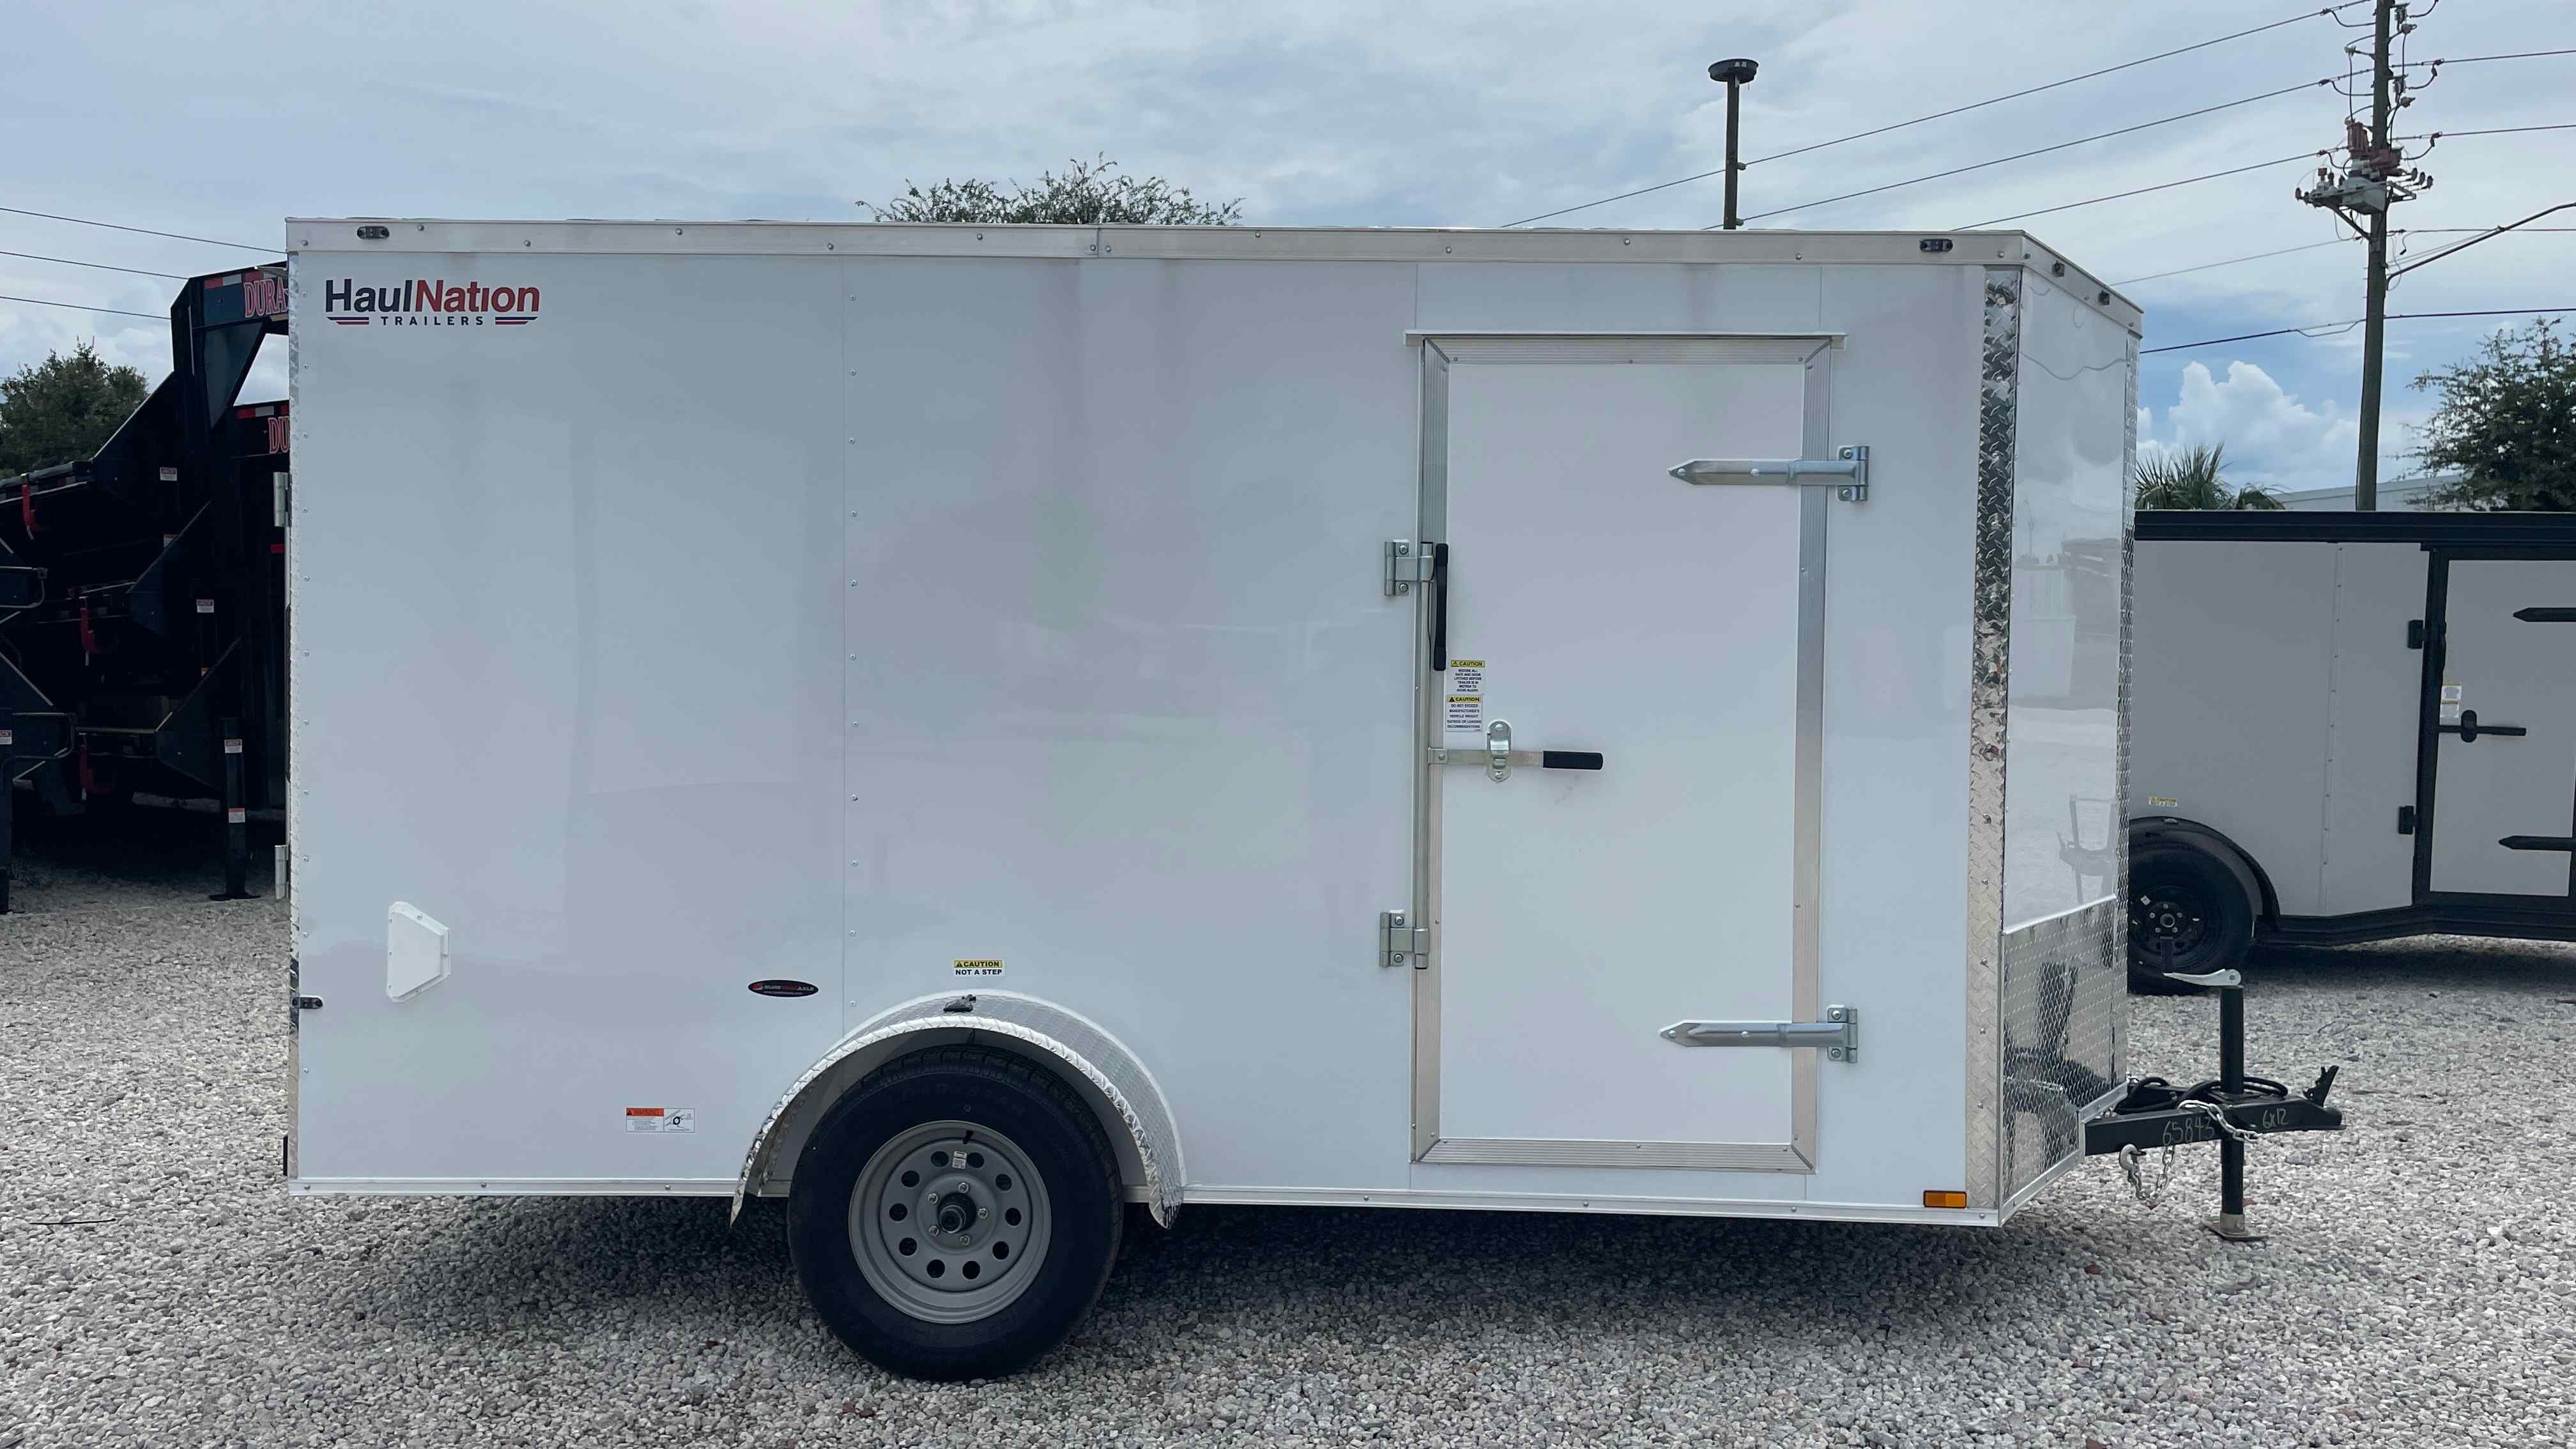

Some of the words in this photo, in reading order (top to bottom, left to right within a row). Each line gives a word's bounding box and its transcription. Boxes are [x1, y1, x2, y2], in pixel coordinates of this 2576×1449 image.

[244, 277, 287, 318] DURA
[381, 316, 484, 325] TRAILERS
[2163, 1117, 2215, 1146] 65843
